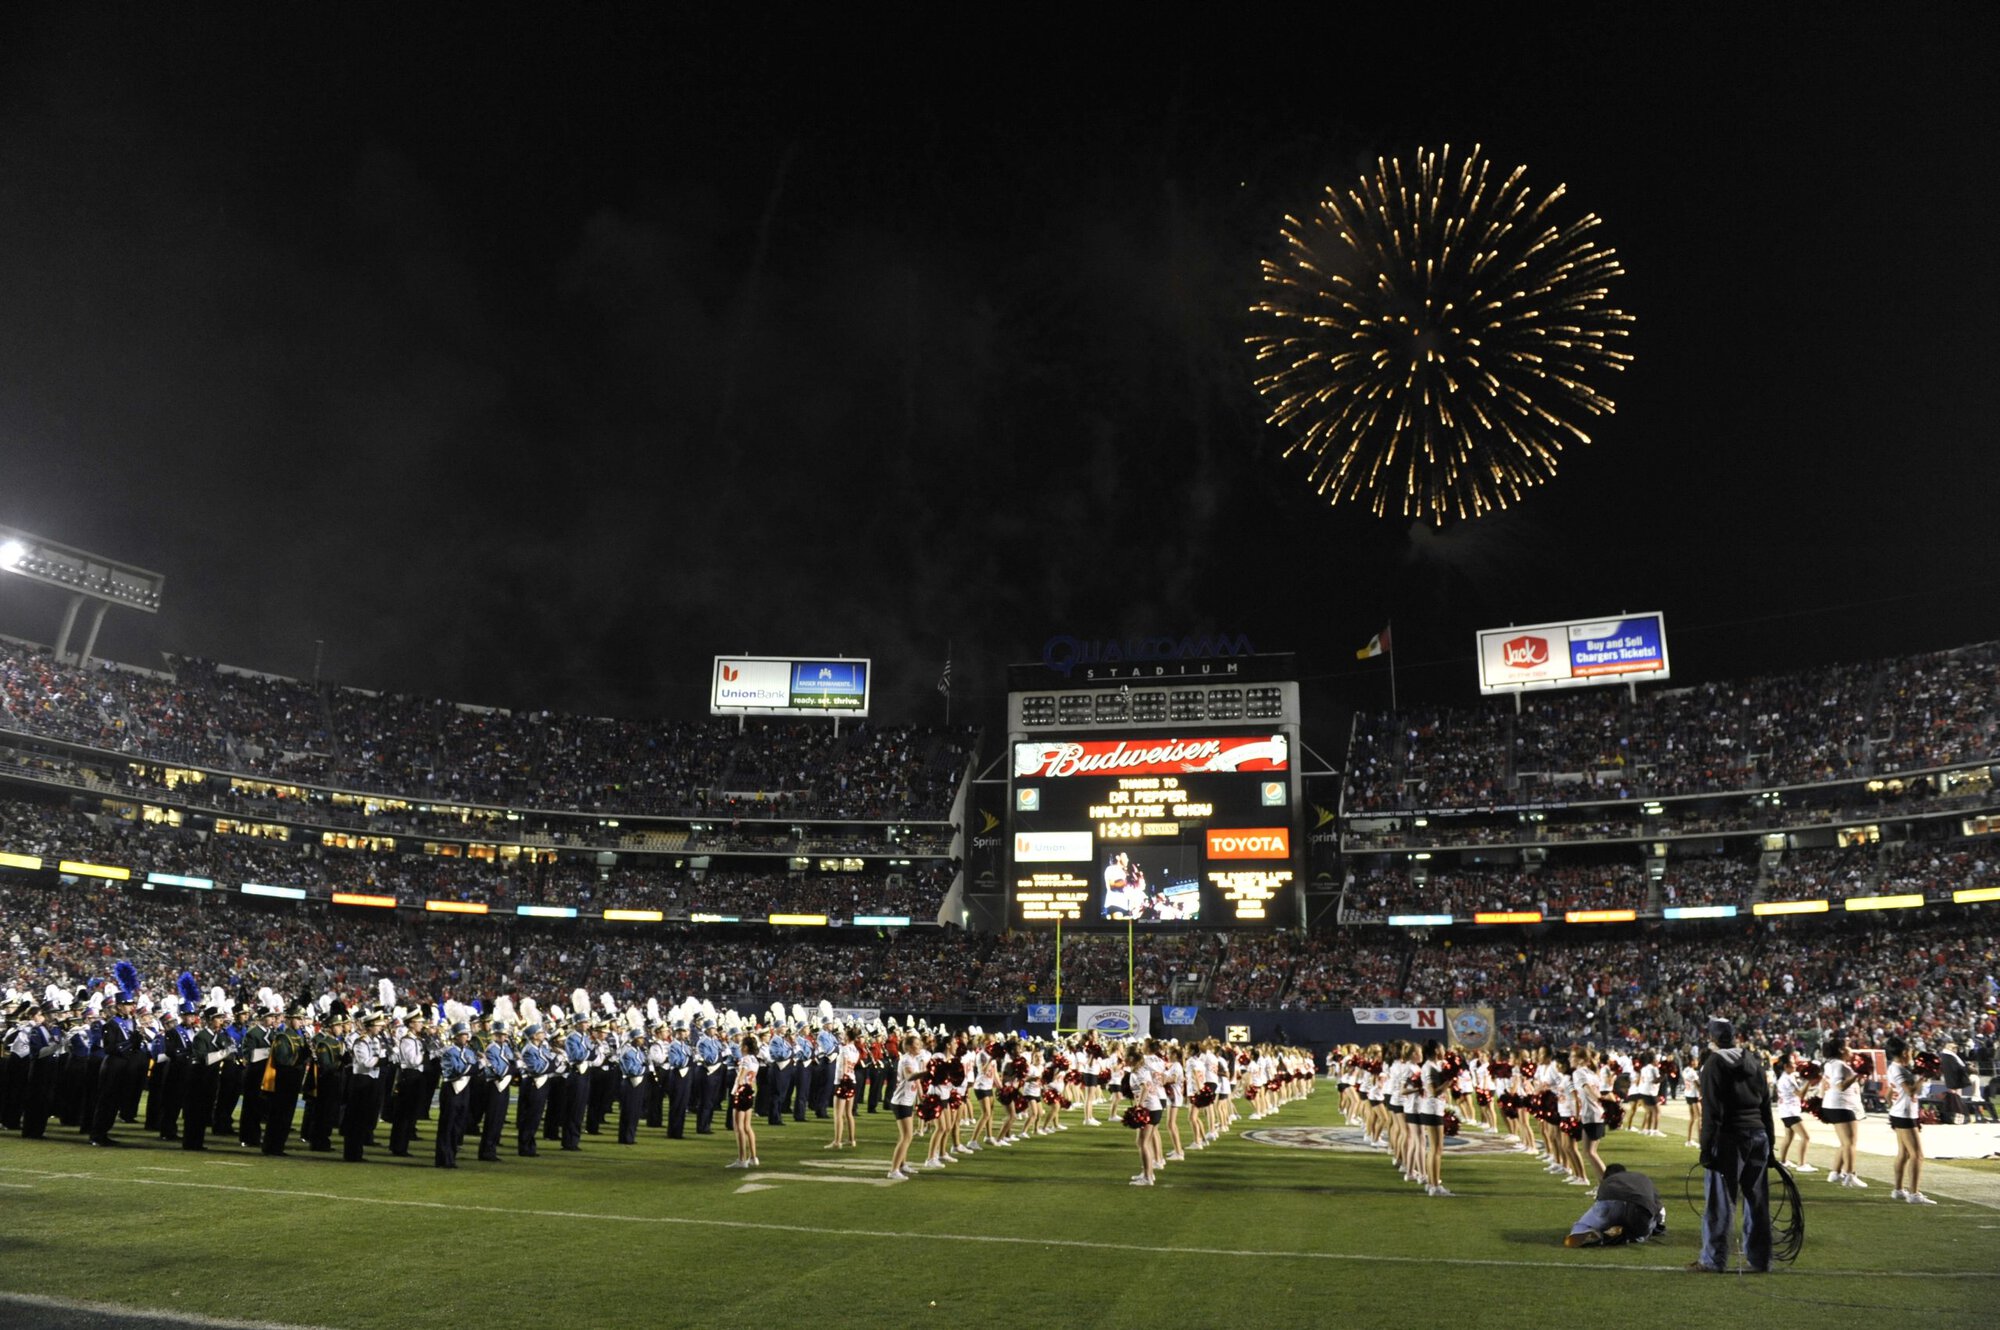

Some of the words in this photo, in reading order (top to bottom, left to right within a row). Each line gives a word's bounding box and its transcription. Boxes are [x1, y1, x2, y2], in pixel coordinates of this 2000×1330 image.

[1587, 640, 1604, 651] Buy
[1606, 638, 1623, 649] and
[1625, 635, 1643, 647] Sell
[1505, 639, 1548, 666] Jack
[1576, 650, 1618, 663] Chargers
[1619, 646, 1656, 659] Tickets!
[1087, 663, 1238, 678] STADIUM
[1041, 738, 1220, 777] Budweiser
[1118, 778, 1159, 789] THANKS
[1163, 778, 1178, 788] TO
[1109, 791, 1129, 803] DR
[1134, 790, 1187, 803] PEPPER
[1089, 805, 1165, 818] HALFTIME
[1173, 803, 1212, 816] SHOW
[973, 836, 1002, 848] Sprint
[1210, 836, 1285, 852] TOYOTA
[1306, 832, 1338, 844] Sprint
[1417, 1010, 1437, 1027] N
[1229, 1026, 1248, 1041] 25
